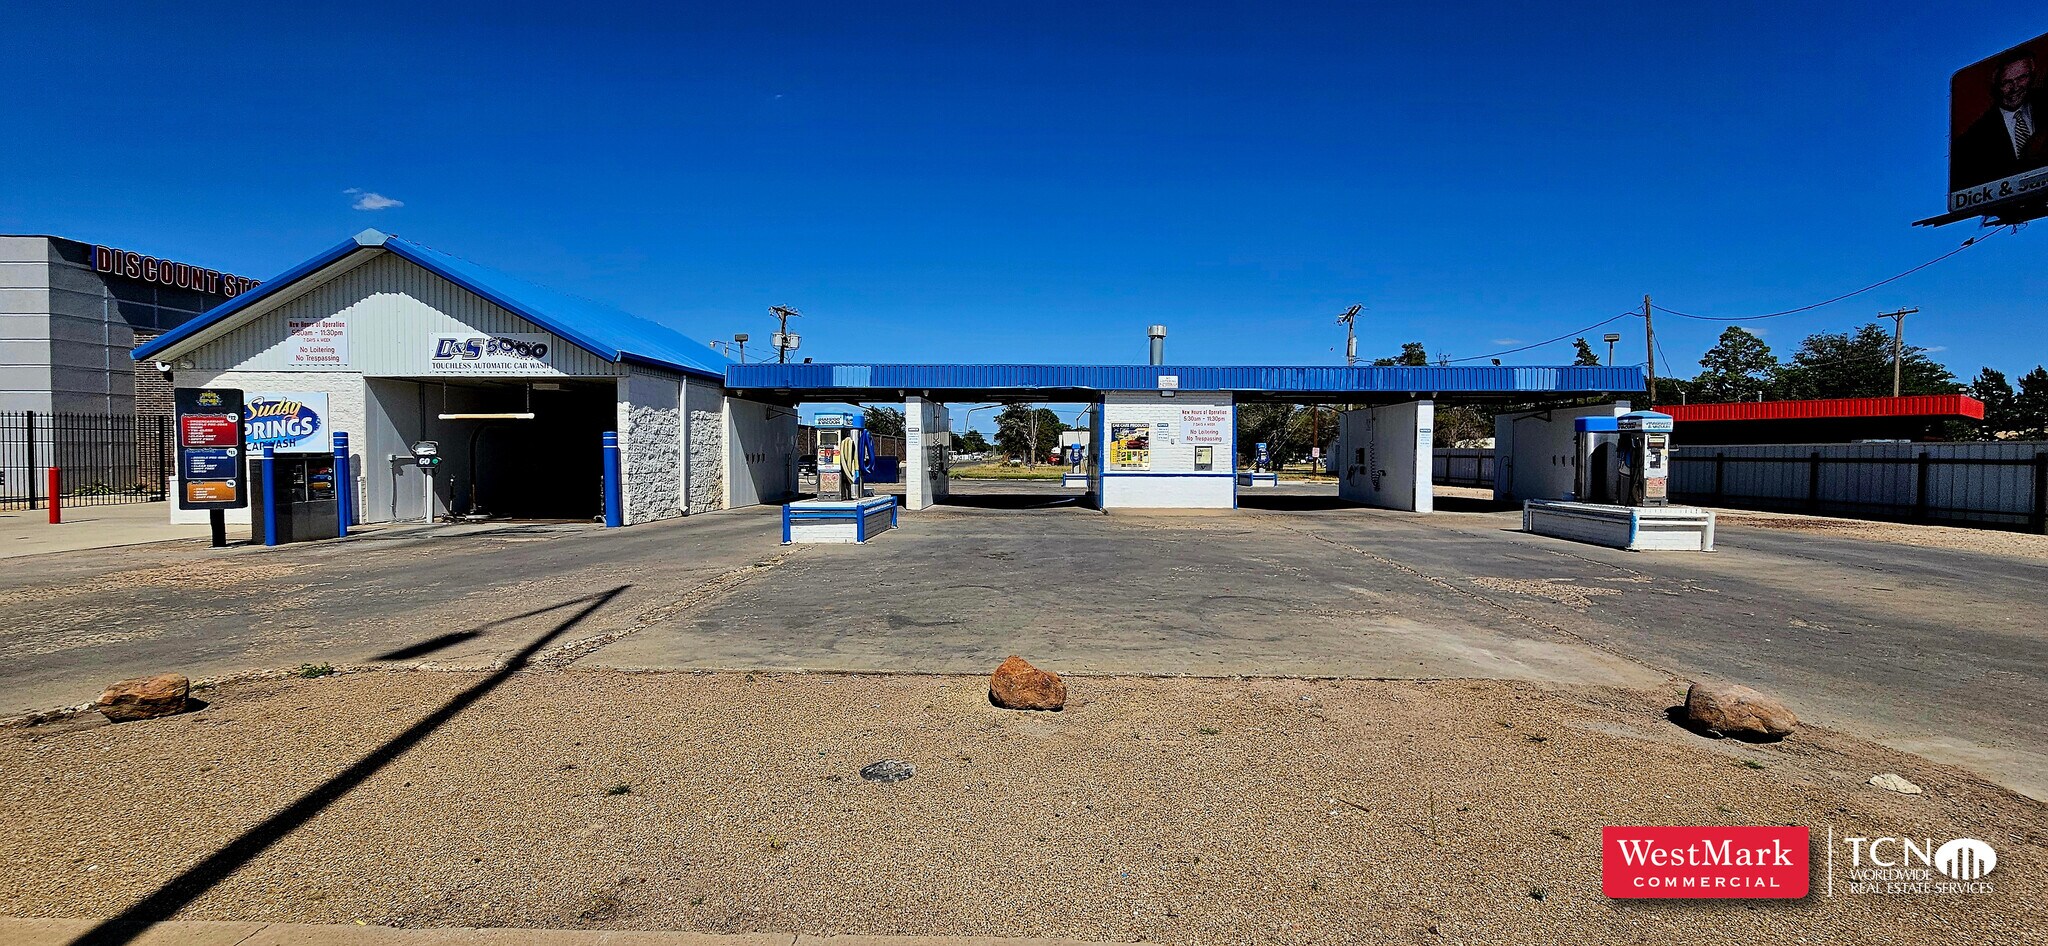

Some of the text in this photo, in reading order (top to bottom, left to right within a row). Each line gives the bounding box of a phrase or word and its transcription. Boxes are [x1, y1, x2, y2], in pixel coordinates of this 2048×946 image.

[1956, 186, 1994, 207] Dick
[1999, 180, 2013, 196] &
[96, 245, 218, 293] DISCOUNT
[309, 346, 336, 354] Loitering
[432, 337, 549, 360] D&S 5000
[245, 396, 302, 421] Sudsy
[274, 438, 297, 450] ASH
